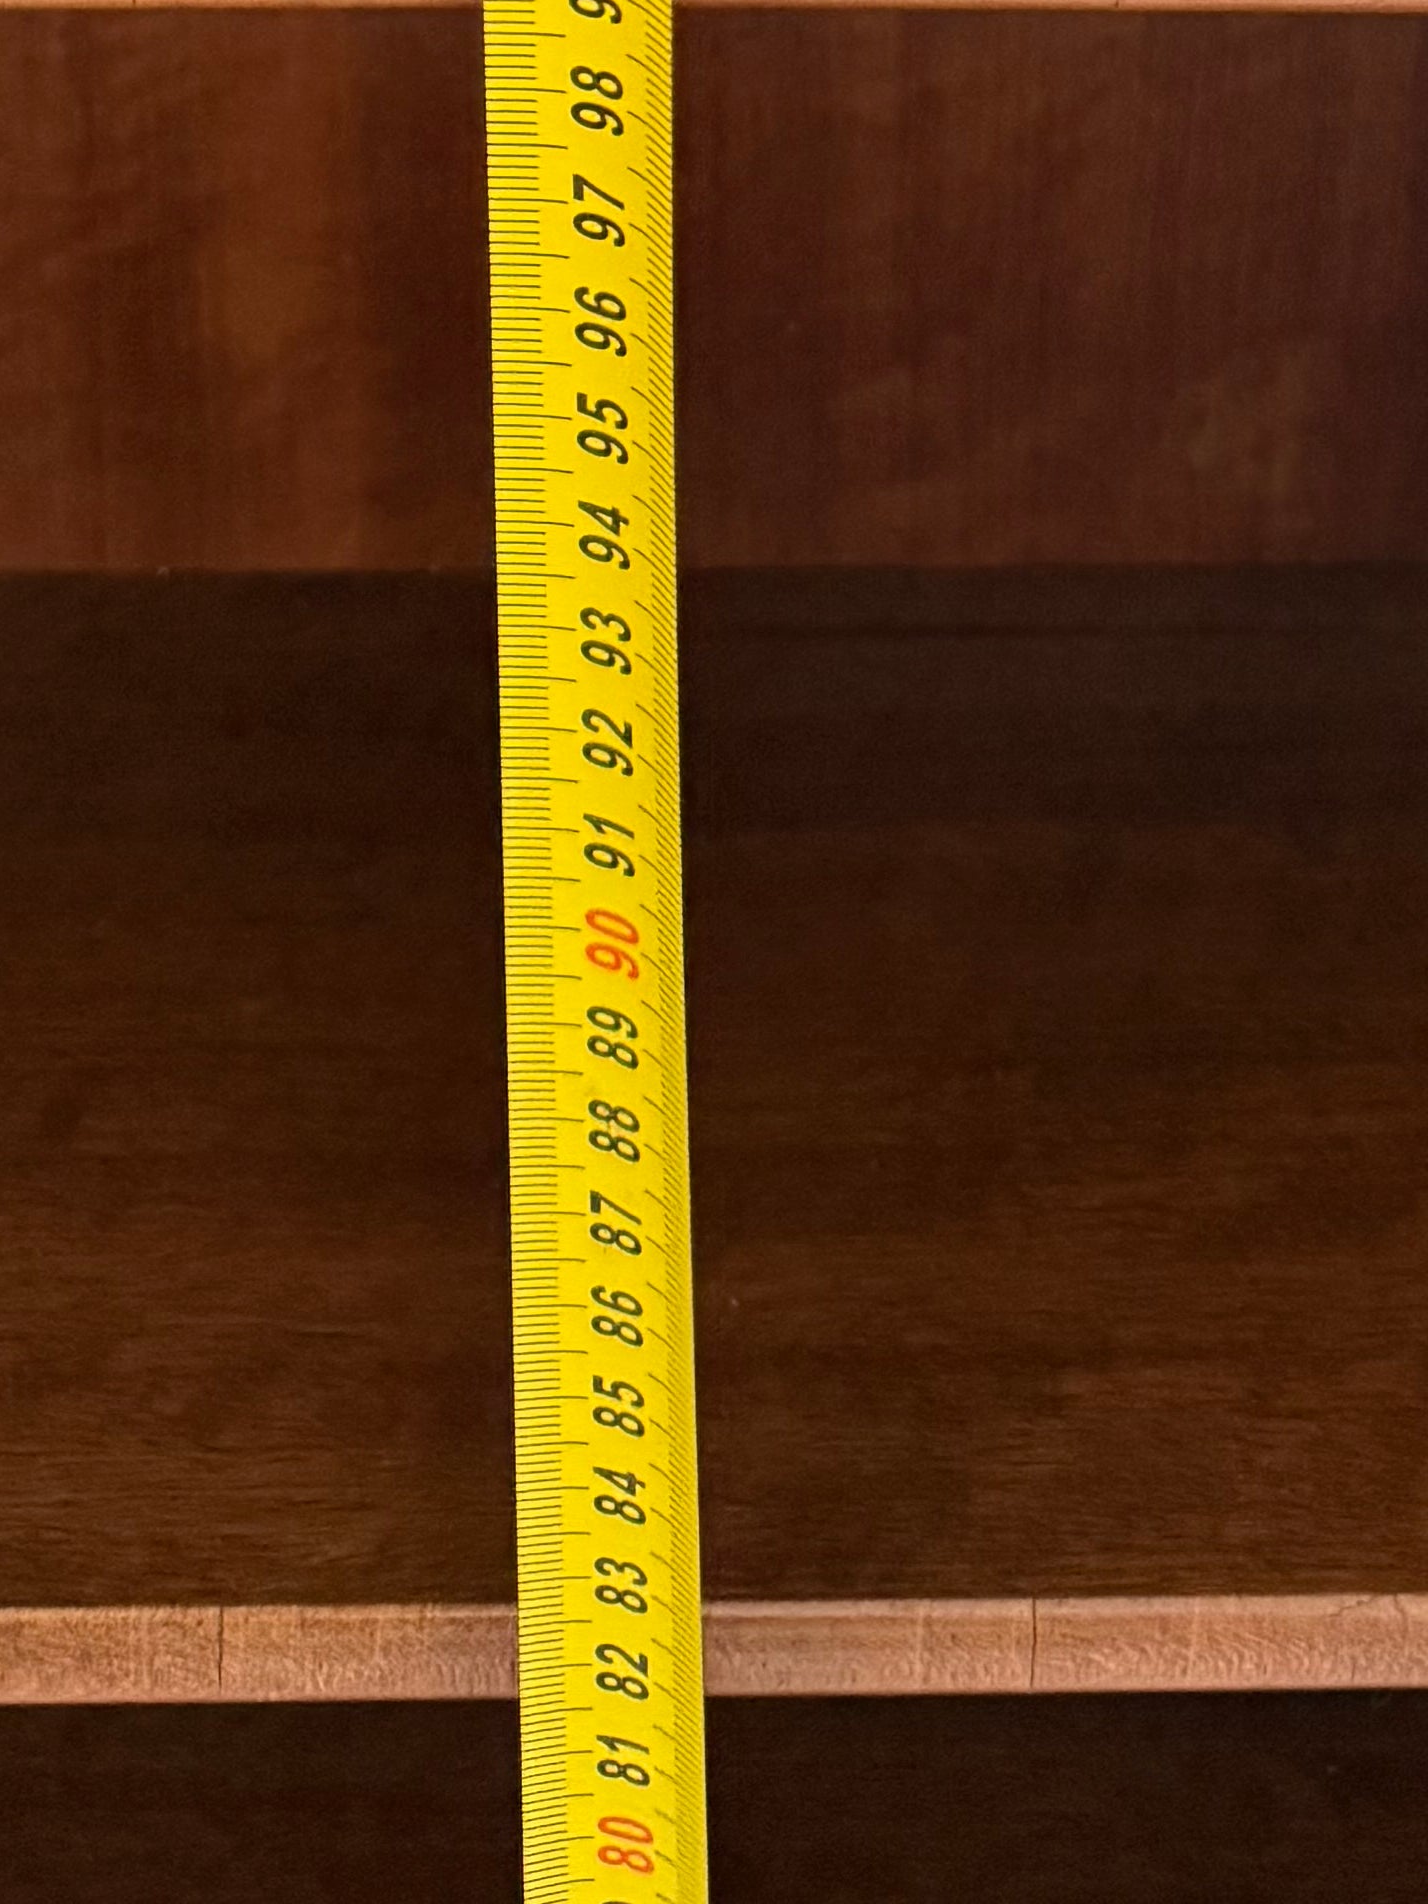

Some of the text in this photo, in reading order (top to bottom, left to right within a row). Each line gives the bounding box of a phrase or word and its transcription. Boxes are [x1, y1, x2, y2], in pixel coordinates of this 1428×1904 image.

[569, 65, 625, 137] 98
[572, 173, 626, 248] 97
[573, 286, 628, 358] 96
[576, 392, 629, 465] 95
[577, 500, 631, 571] 94
[579, 607, 633, 676] 93
[580, 708, 634, 778] 92
[582, 813, 636, 878] 91
[584, 908, 639, 982] 90
[586, 1006, 640, 1071] 89
[587, 1099, 641, 1164] 88
[589, 1190, 643, 1257] 87
[590, 1285, 644, 1348] 86
[592, 1375, 646, 1438] 85
[592, 1466, 647, 1526] 84
[593, 1556, 649, 1615] 83
[594, 1643, 650, 1701] 82
[595, 1734, 651, 1787] 81
[596, 1815, 654, 1875] 80
